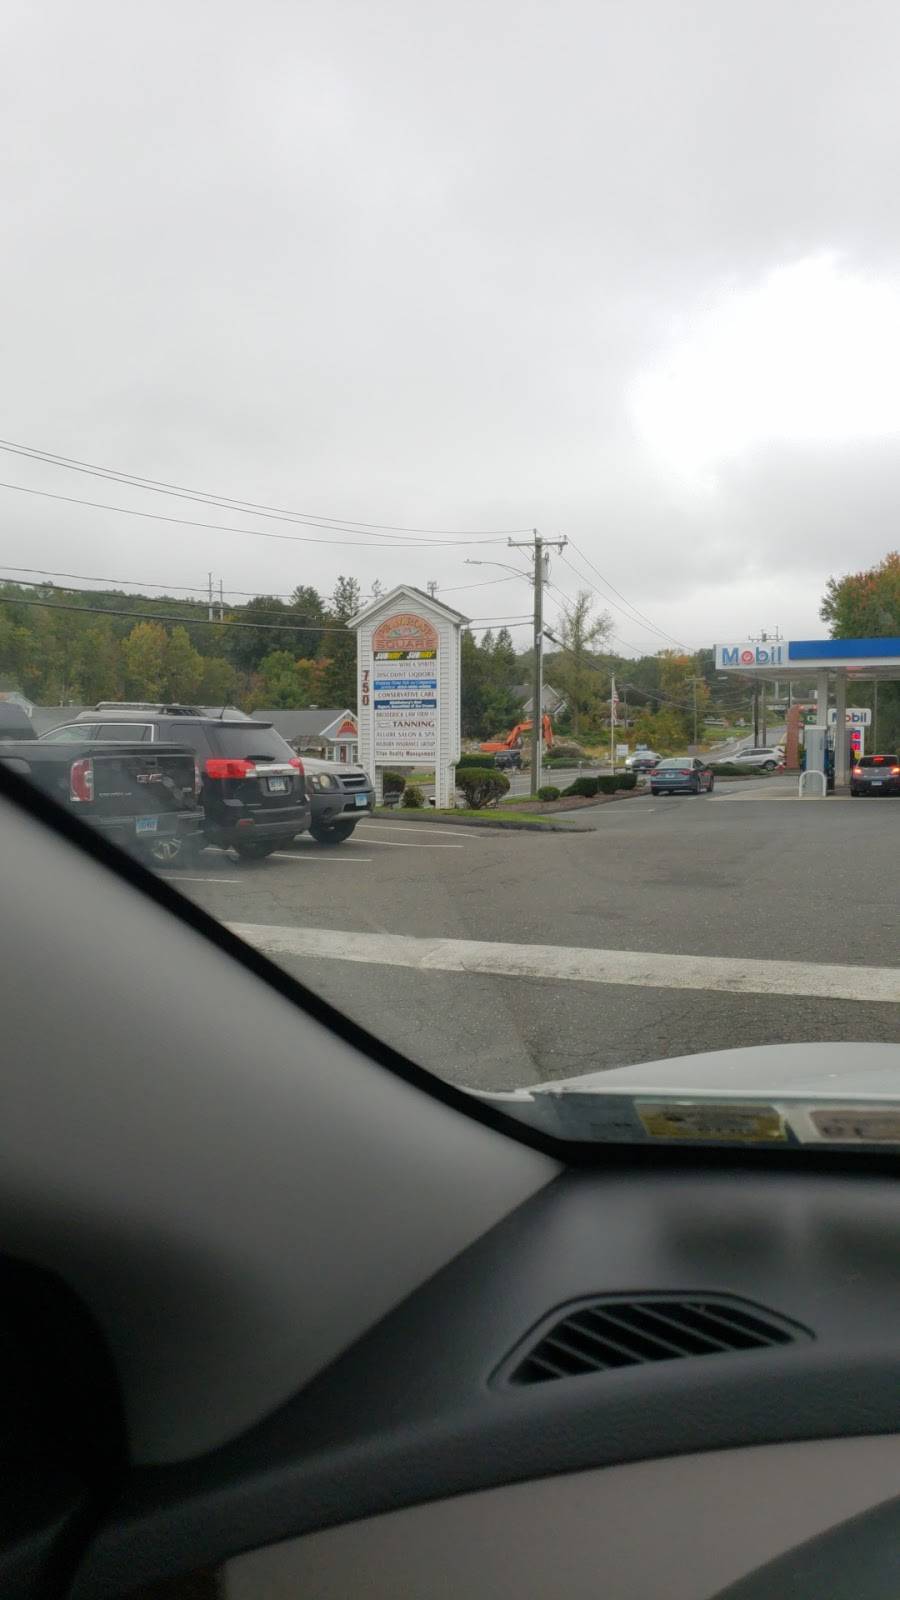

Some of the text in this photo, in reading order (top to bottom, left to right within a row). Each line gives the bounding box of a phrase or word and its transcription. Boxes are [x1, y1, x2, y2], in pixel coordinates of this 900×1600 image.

[722, 646, 783, 665] Mobil
[393, 720, 435, 728] TANNING
[406, 750, 436, 758] Management
